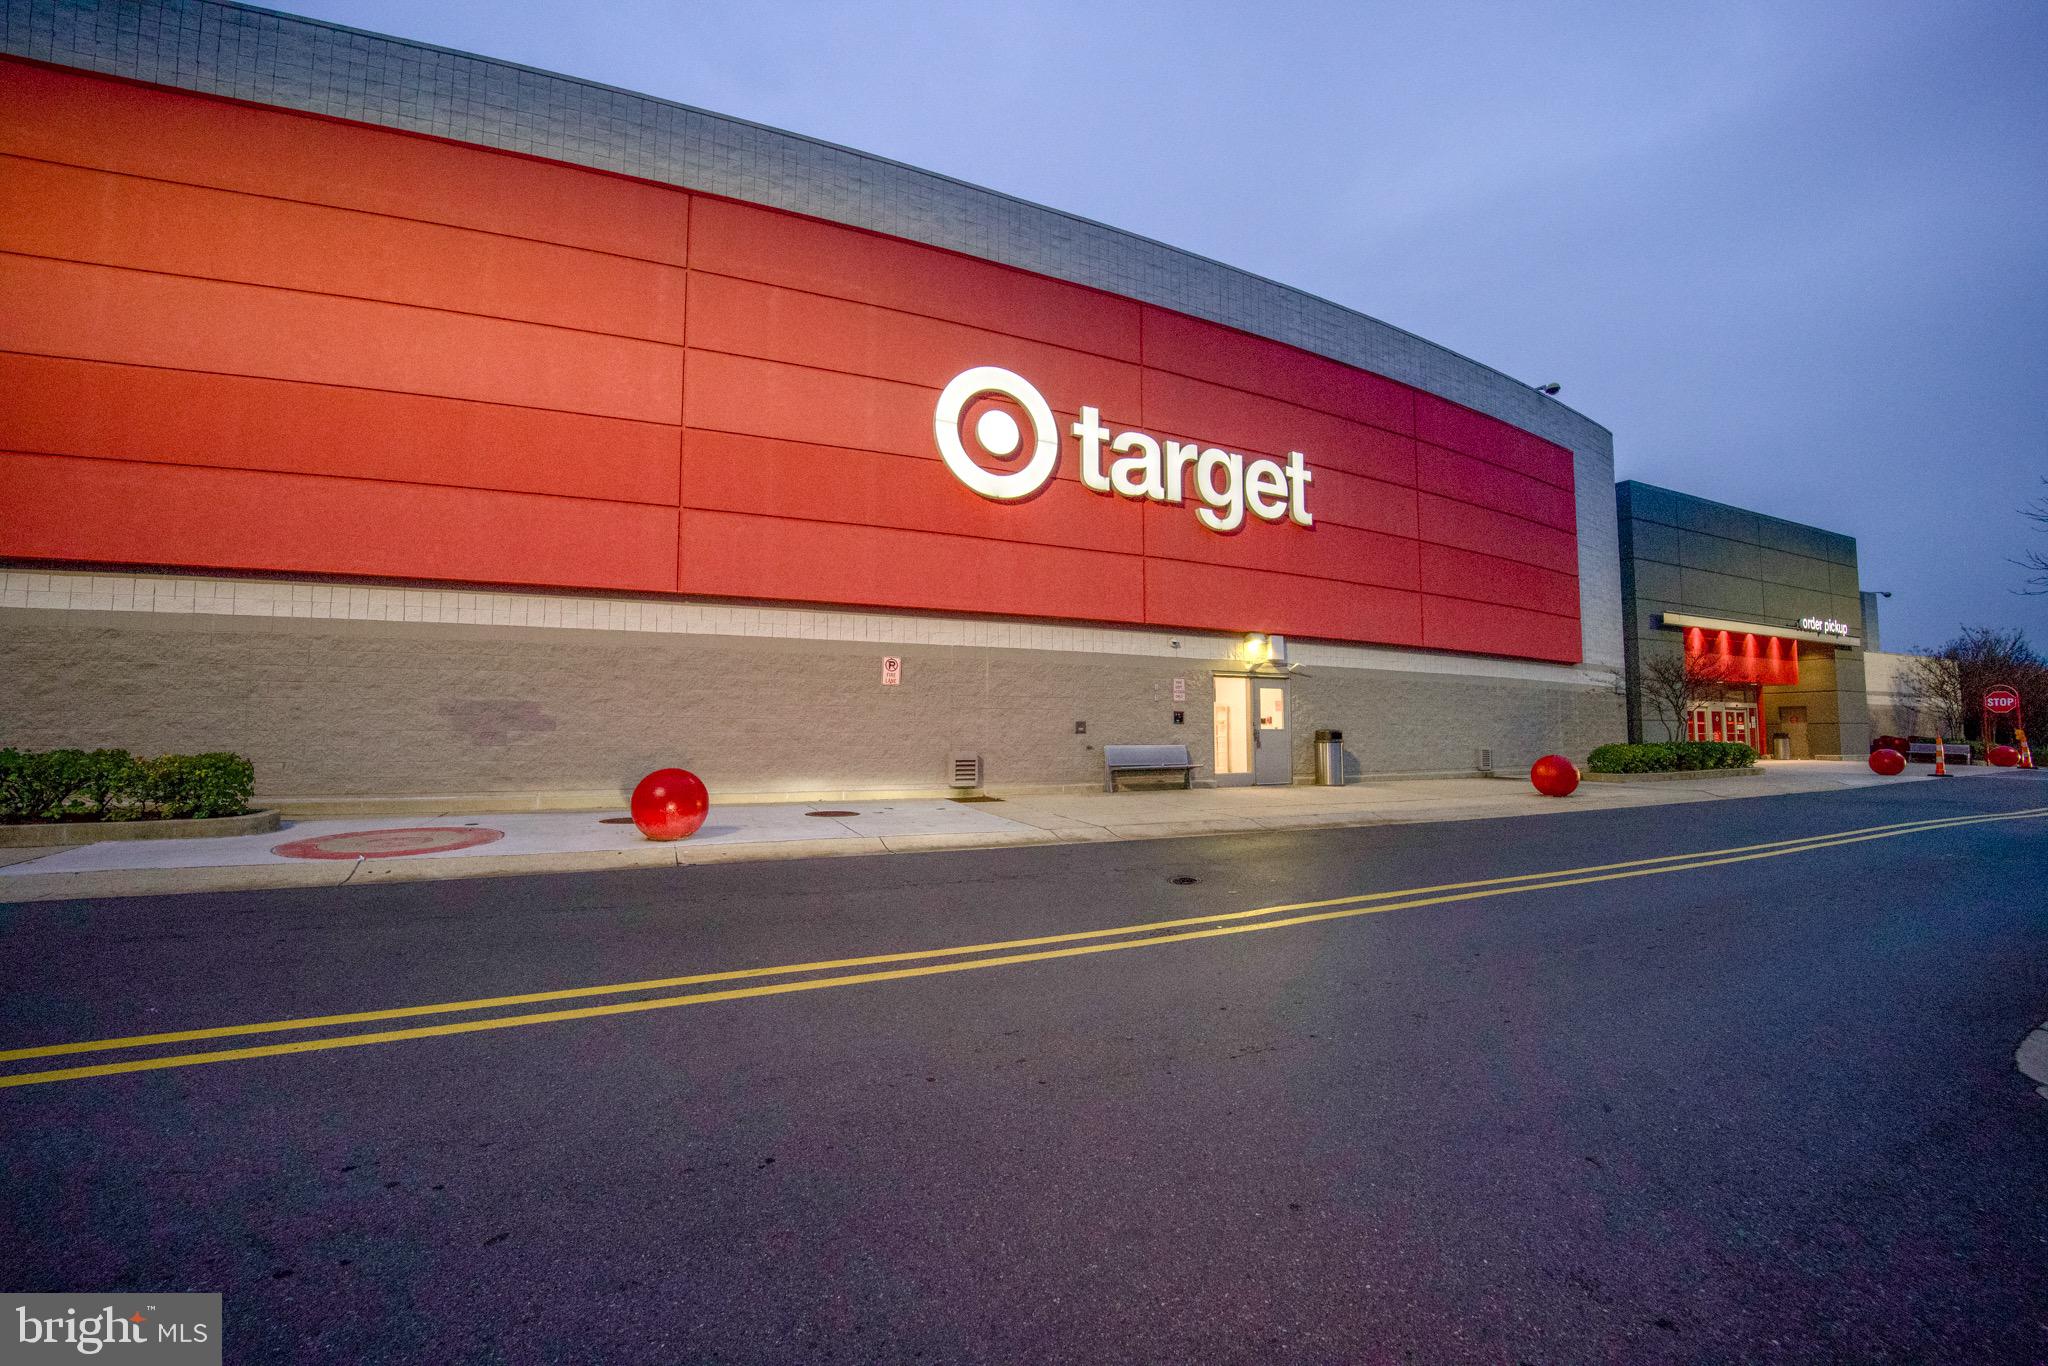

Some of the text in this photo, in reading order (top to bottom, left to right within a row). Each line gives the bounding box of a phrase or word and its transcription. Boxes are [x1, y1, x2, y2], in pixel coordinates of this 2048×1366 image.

[1070, 405, 1313, 533] target
[1802, 616, 1848, 637] order pickup
[1987, 698, 2014, 707] STOP
